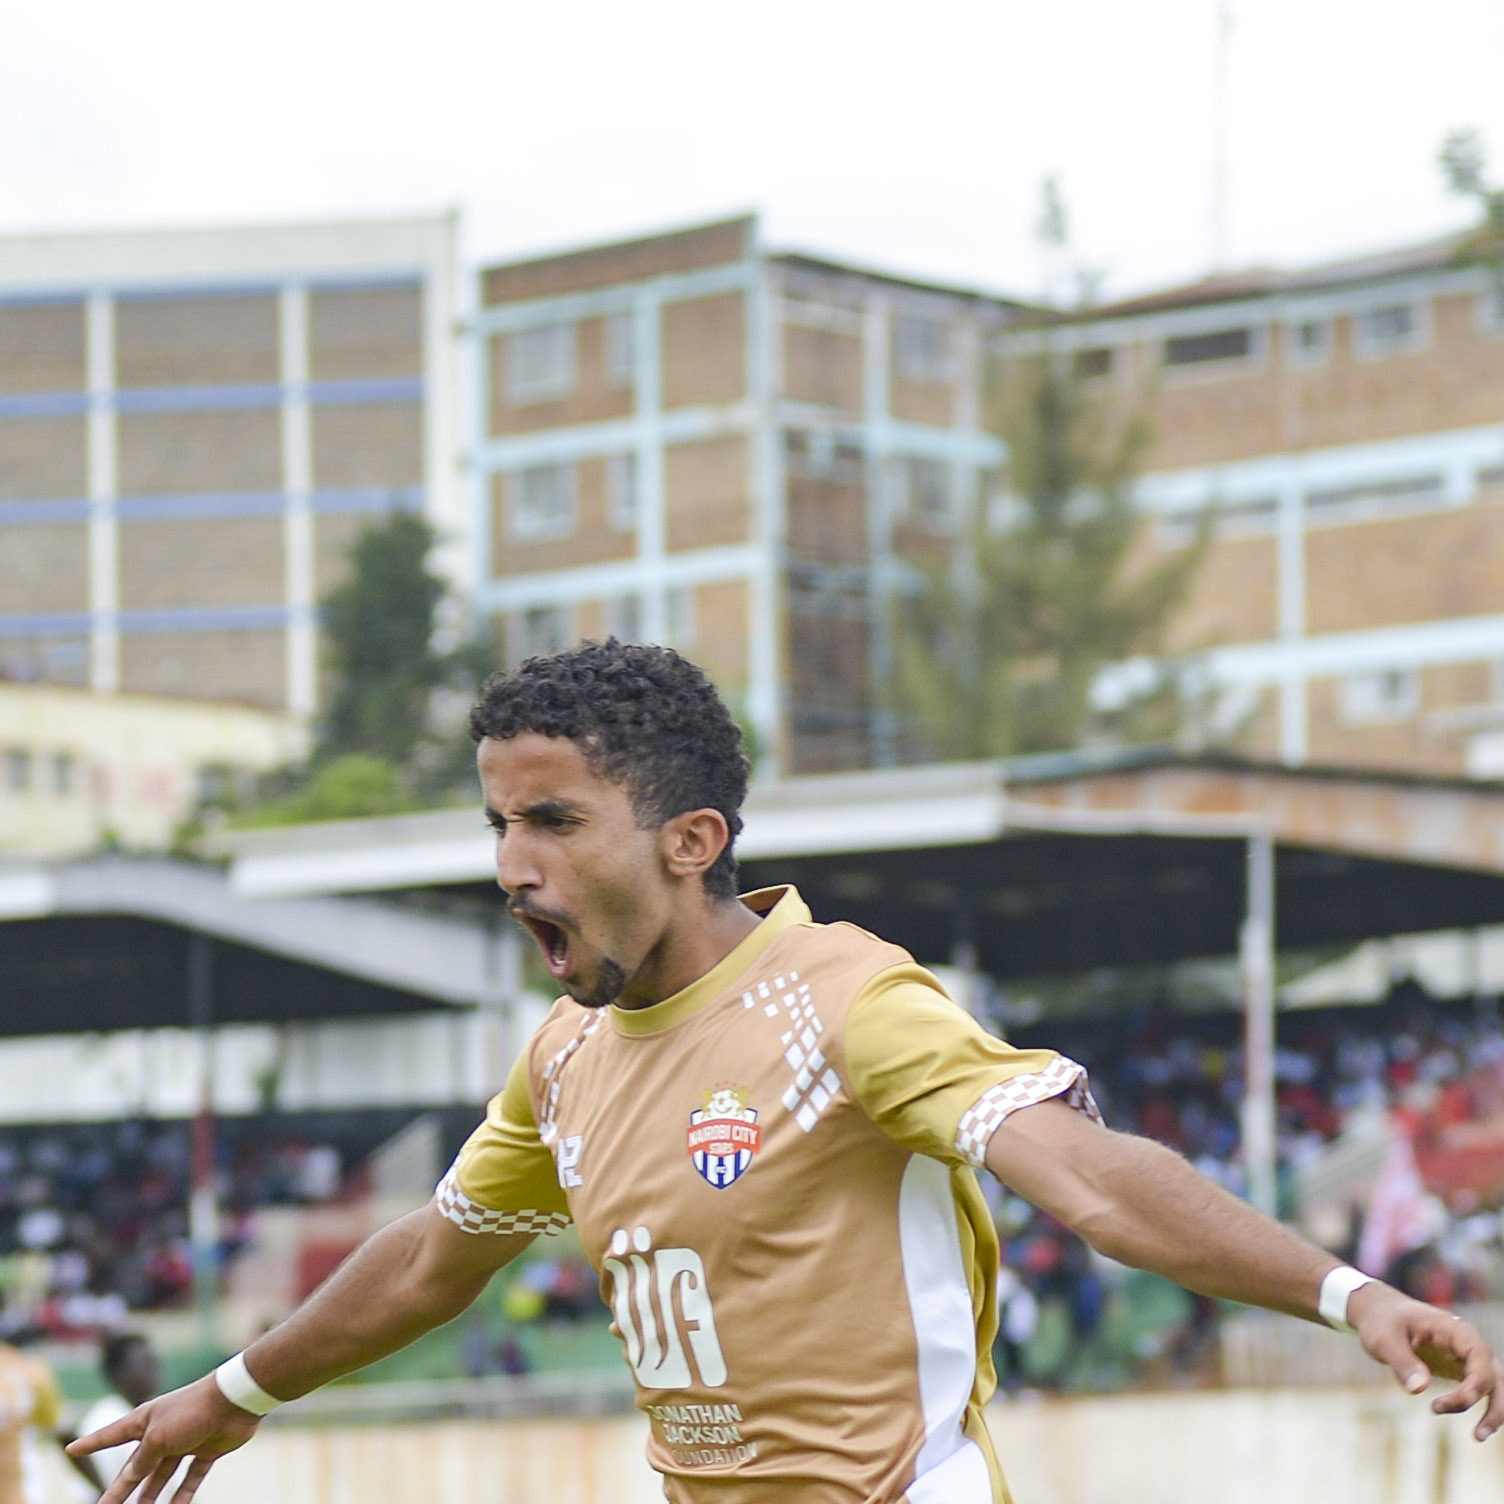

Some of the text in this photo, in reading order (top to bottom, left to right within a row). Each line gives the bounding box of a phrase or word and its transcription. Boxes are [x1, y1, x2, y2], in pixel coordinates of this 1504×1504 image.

[688, 1124, 758, 1148] NAIROBI CITY
[662, 1423, 744, 1445] JACKSON
